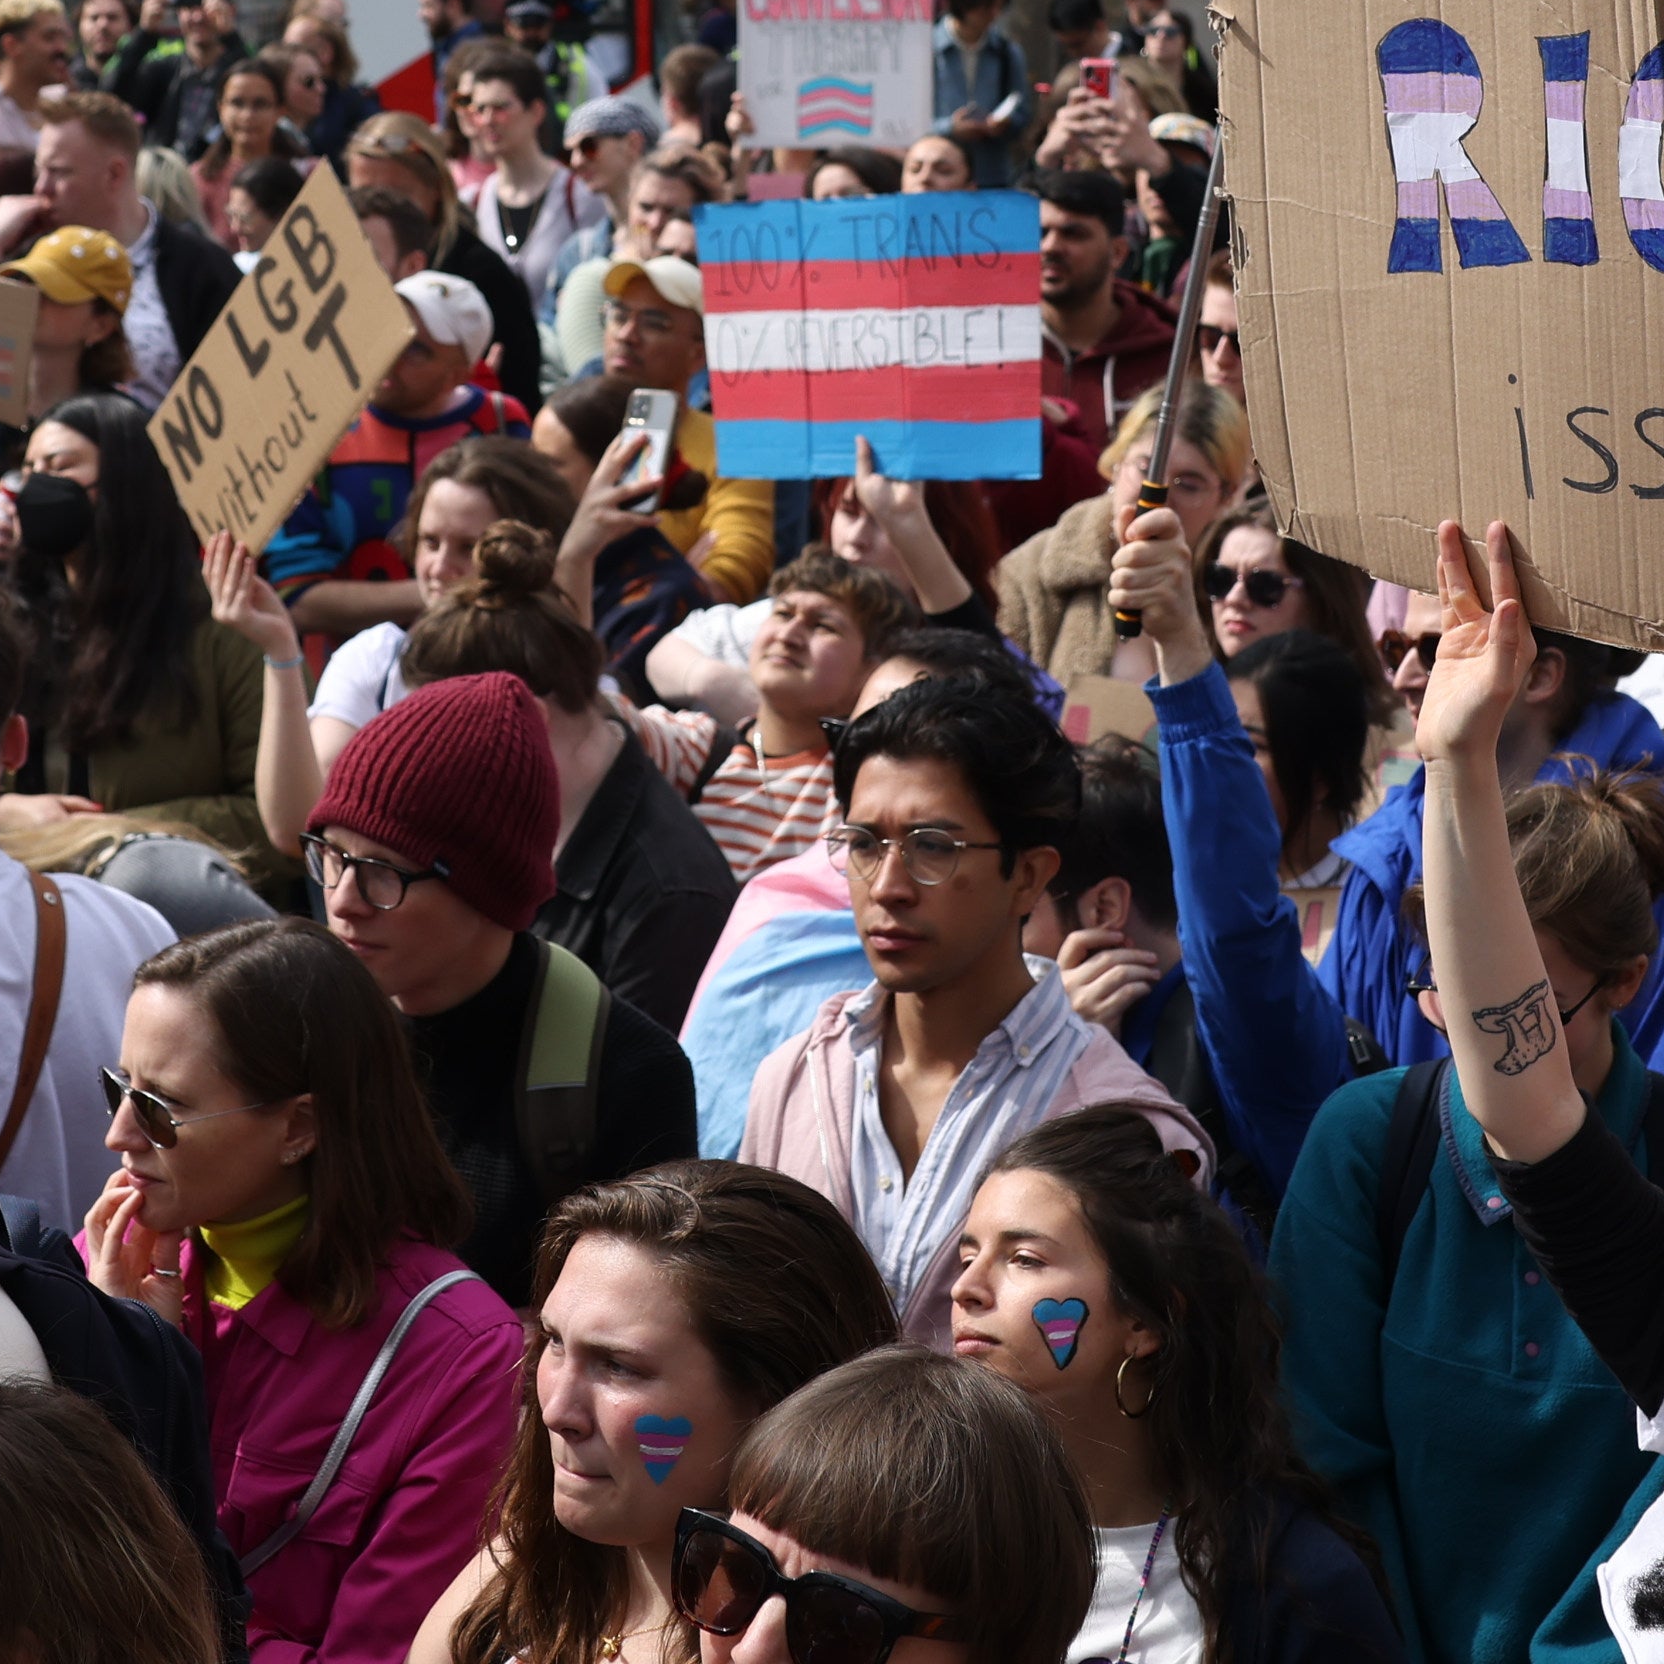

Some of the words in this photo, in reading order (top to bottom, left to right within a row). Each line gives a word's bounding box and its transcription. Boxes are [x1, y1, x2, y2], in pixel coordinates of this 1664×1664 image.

[708, 218, 823, 297] 100%
[161, 364, 224, 484] NO
[225, 203, 337, 380] LGB
[302, 281, 362, 392] T
[715, 316, 772, 387] 0%
